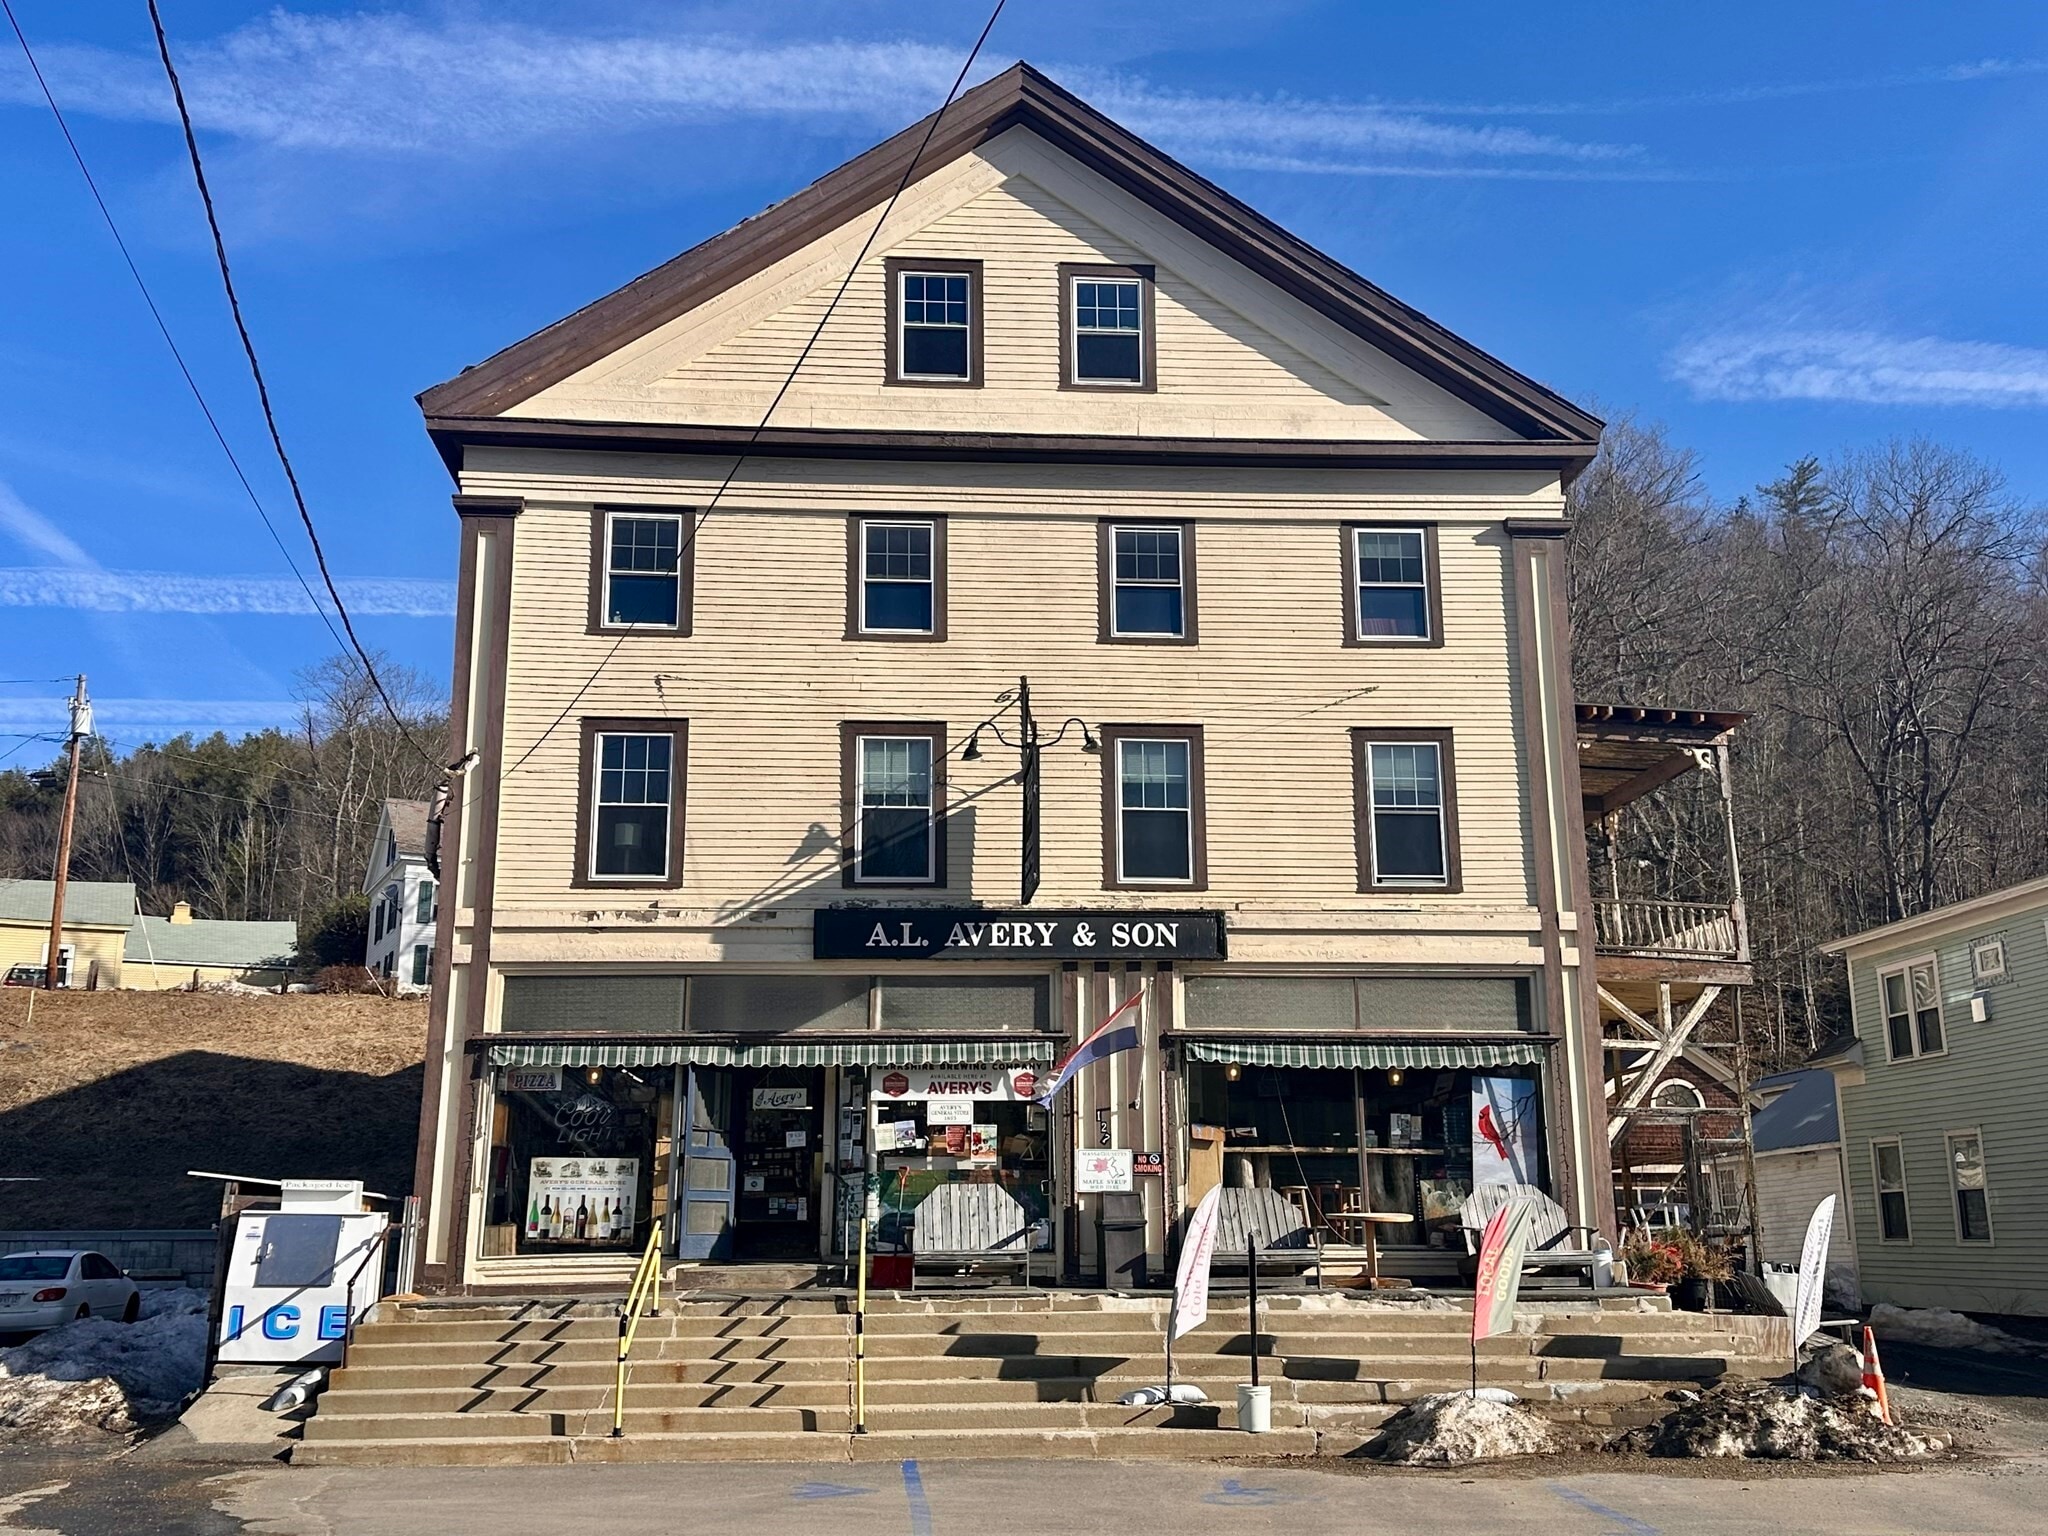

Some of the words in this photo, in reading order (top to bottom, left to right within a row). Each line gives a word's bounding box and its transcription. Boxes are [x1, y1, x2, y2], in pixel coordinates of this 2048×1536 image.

[865, 921, 930, 948] A.L.
[944, 921, 1058, 948] AVERY
[1072, 921, 1097, 948] &
[1110, 922, 1180, 948] SON
[876, 1062, 935, 1071] BERKSHIRE
[939, 1062, 988, 1071] BREWING
[991, 1061, 1043, 1071] COMPANY
[513, 1071, 557, 1089] PIZZA
[927, 1081, 992, 1095] AVERY'S
[557, 1126, 616, 1143] LIGHT
[1137, 1155, 1147, 1163] NO
[1133, 1164, 1162, 1173] SMOKING
[285, 1181, 333, 1190] Packaged
[1480, 1247, 1500, 1297] LOCAL
[1496, 1246, 1515, 1302] GOODS
[226, 1304, 356, 1341] ICE
